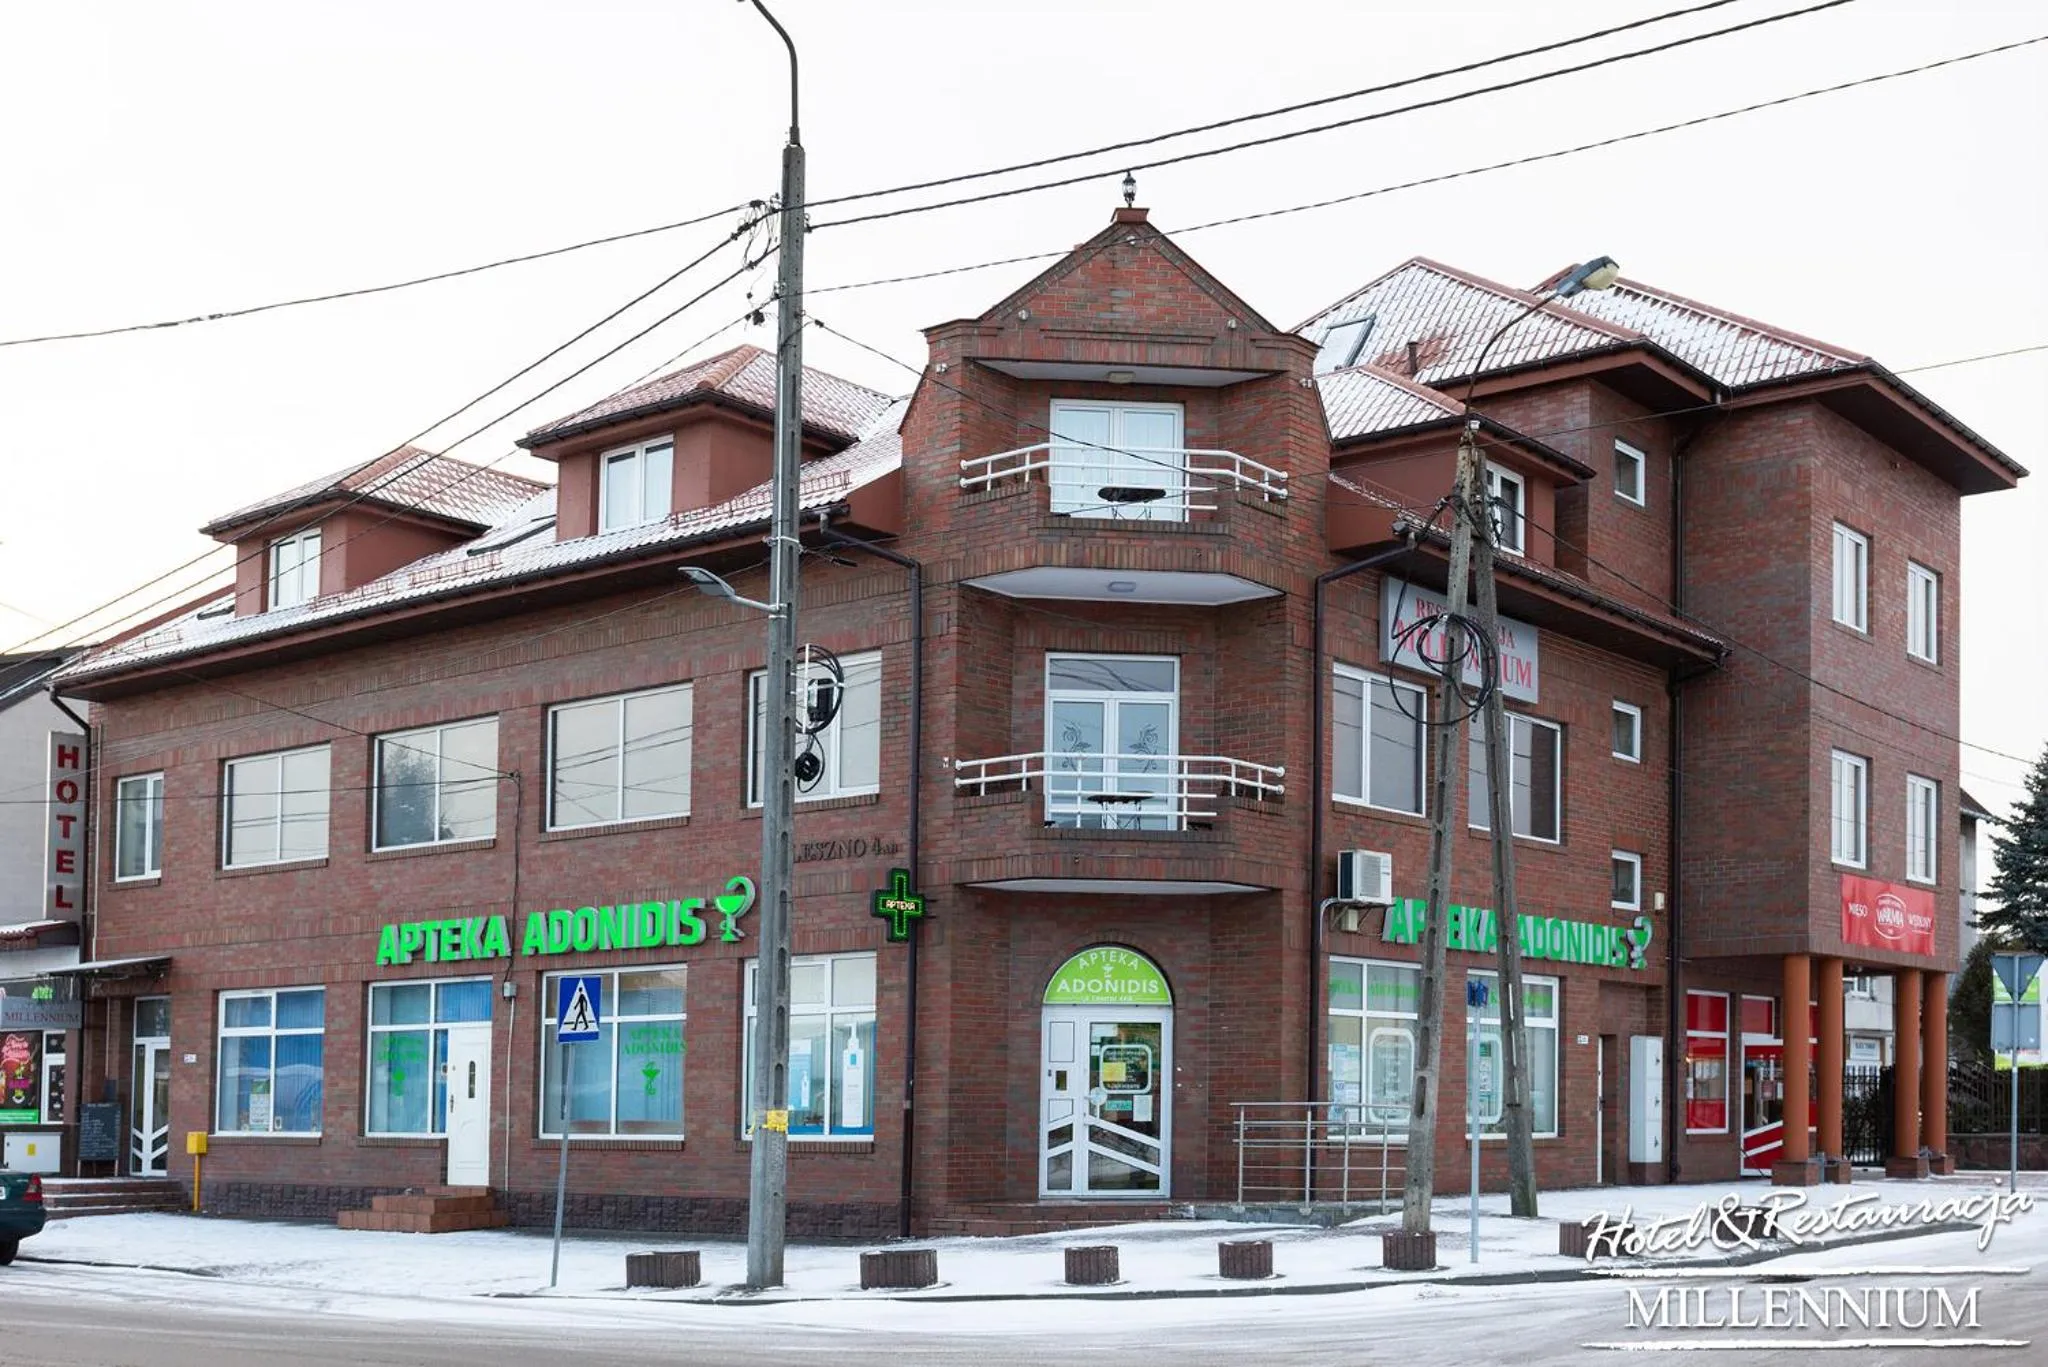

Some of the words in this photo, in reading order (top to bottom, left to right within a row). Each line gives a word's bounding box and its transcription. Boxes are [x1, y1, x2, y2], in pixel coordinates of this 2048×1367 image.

[56, 744, 79, 909] HOTEL
[885, 899, 916, 911] APTEKA
[1387, 895, 1498, 953] APEKA
[376, 915, 511, 966] APTEKA
[522, 897, 707, 956] ADONIDIS
[1079, 950, 1139, 971] APTEKA
[1056, 978, 1159, 994] ADONIDIS
